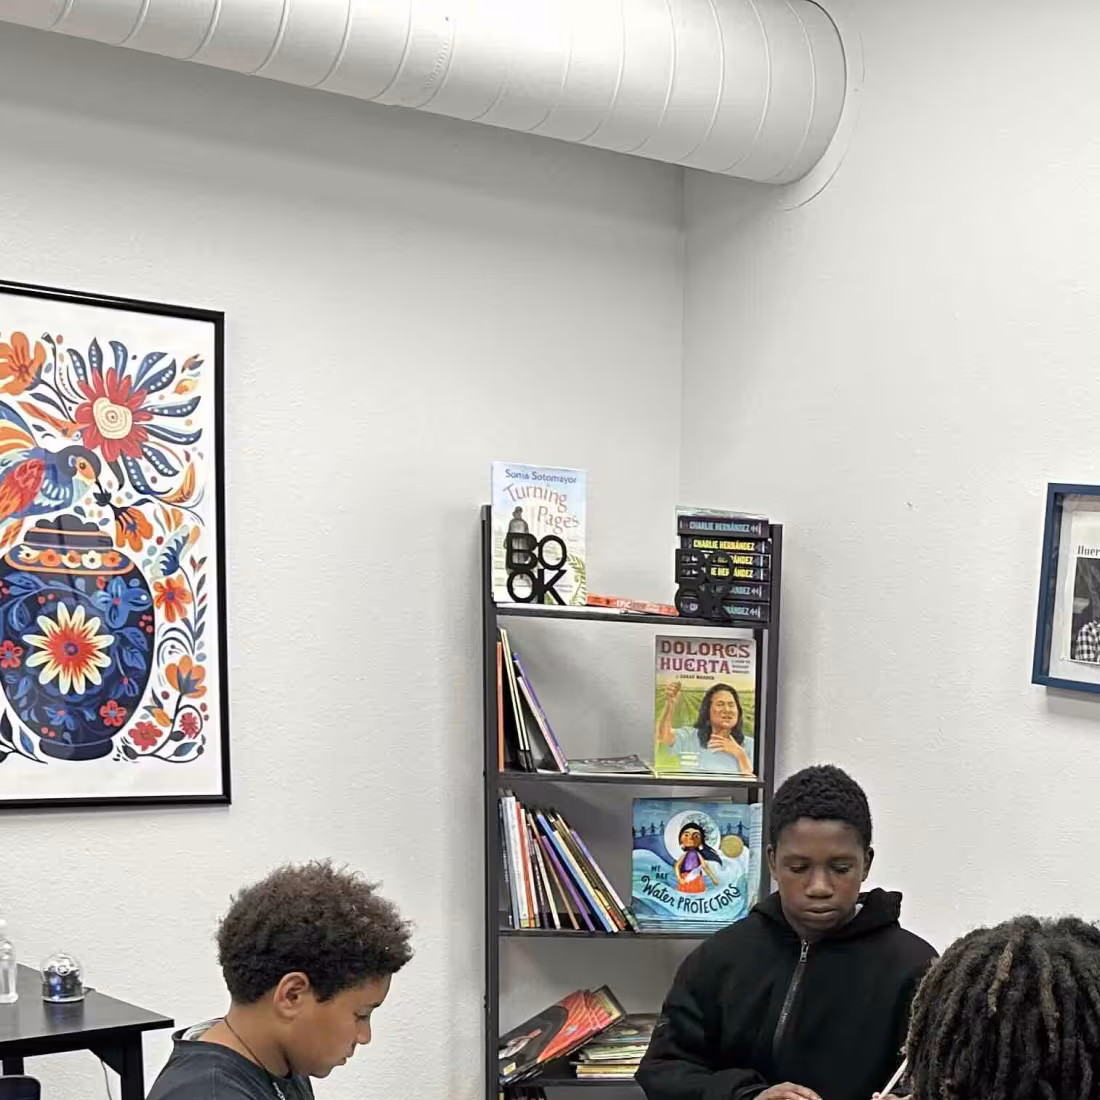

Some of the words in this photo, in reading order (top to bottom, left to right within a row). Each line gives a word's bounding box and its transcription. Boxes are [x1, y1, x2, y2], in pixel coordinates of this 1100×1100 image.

[505, 469, 529, 480] Sonia
[532, 471, 577, 484] Sotomayor
[503, 483, 567, 513] Turning
[537, 505, 580, 534] Pages
[693, 539, 719, 549] CHARLIE
[660, 640, 750, 658] DOLORES
[660, 657, 731, 674] HUERTA
[655, 872, 669, 880] ARE
[641, 875, 674, 907] Water
[677, 883, 741, 914] PROTECTORS
